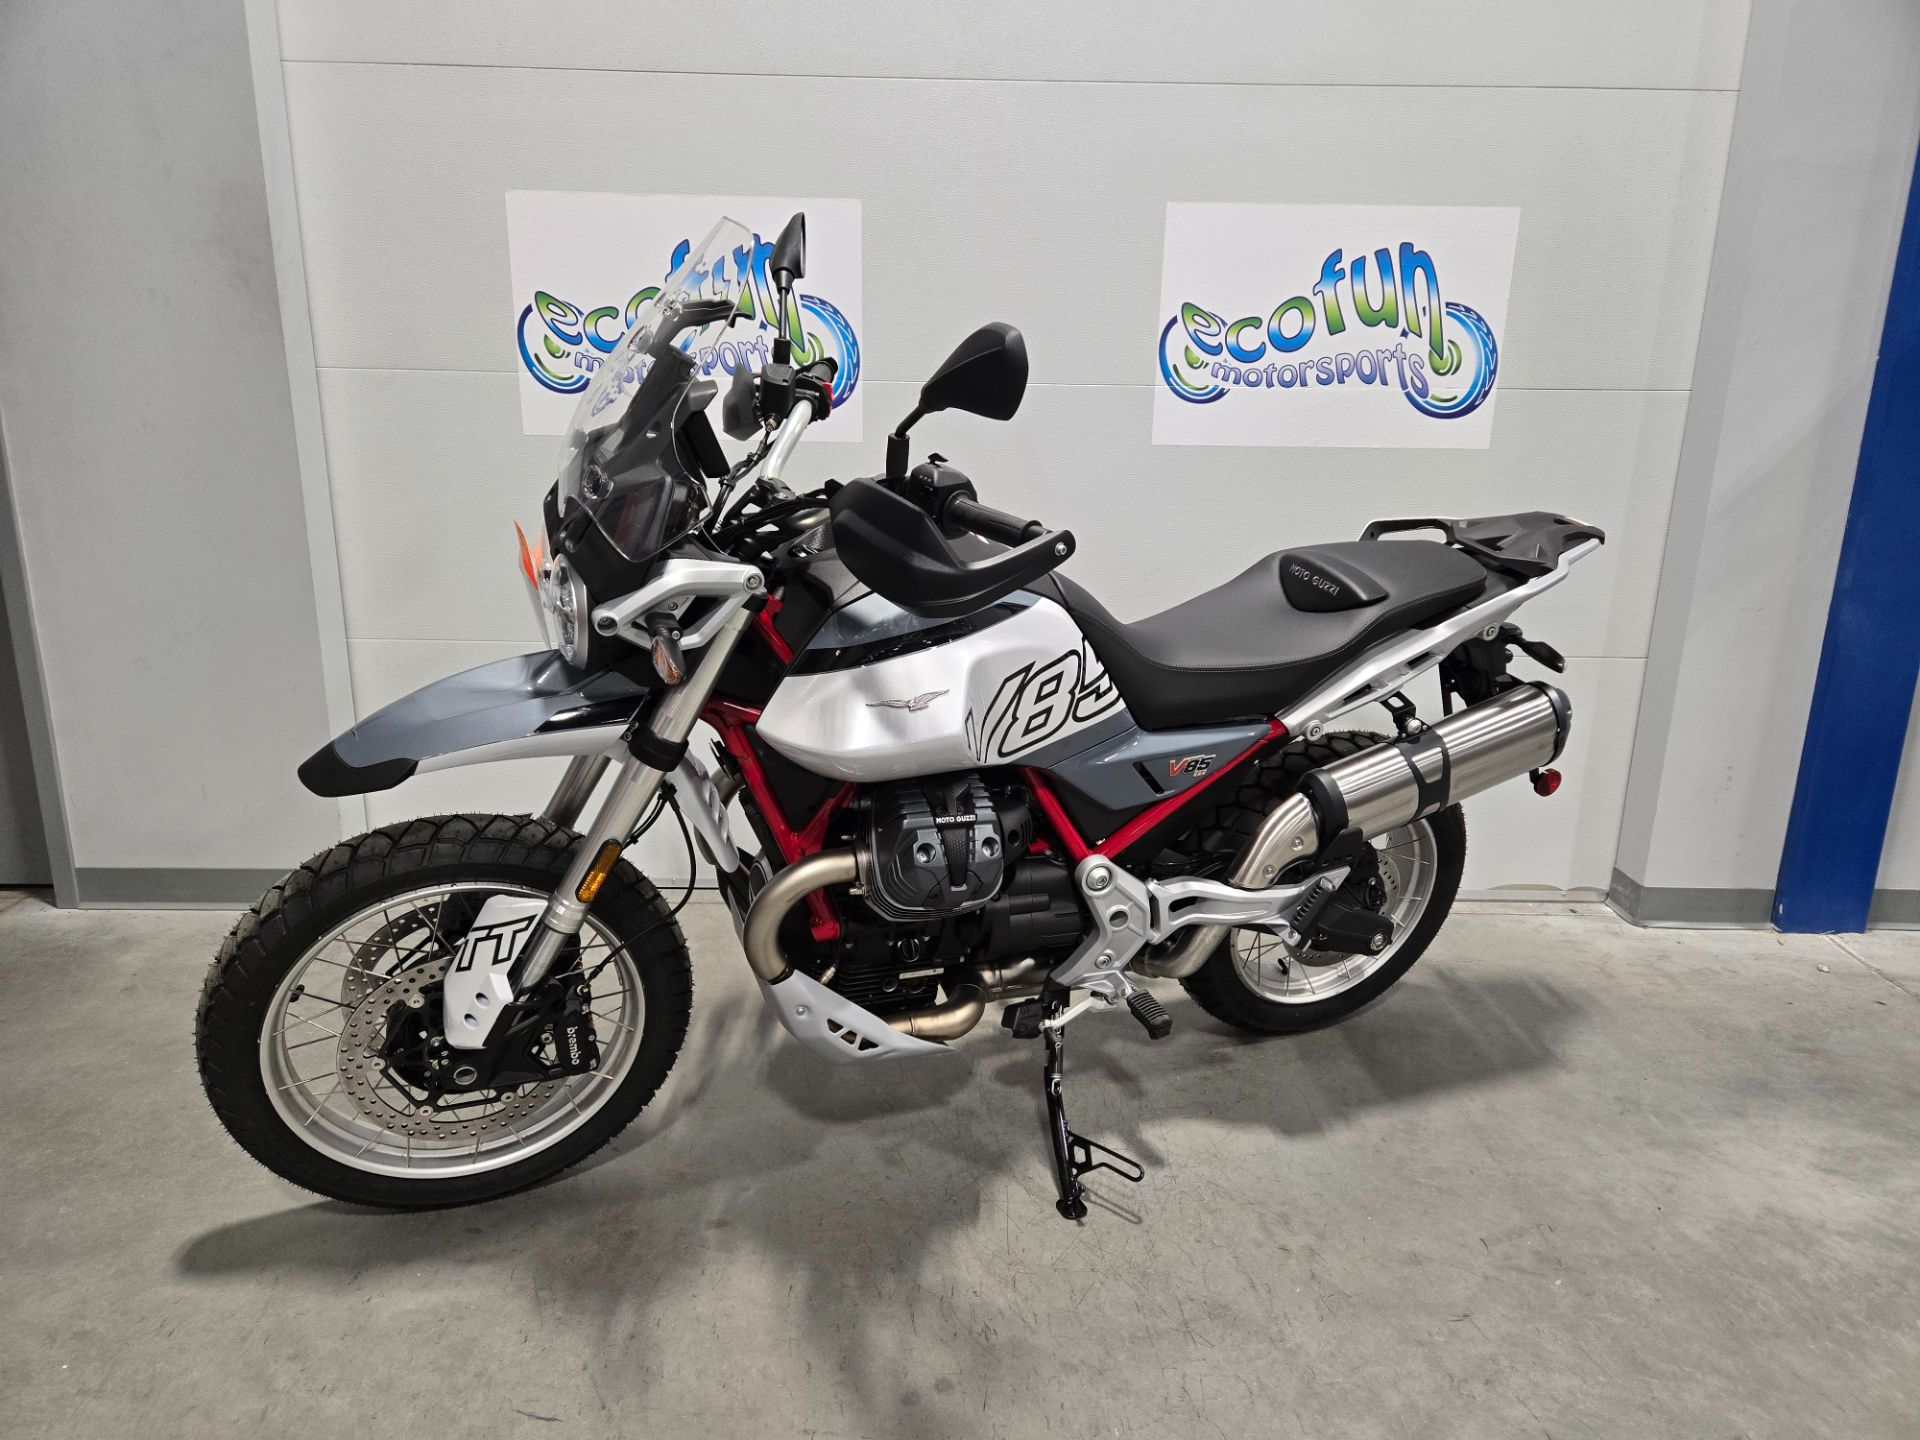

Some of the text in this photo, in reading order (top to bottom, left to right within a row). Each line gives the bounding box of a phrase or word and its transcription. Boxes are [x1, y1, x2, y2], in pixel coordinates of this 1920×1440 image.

[1181, 242, 1444, 361] ecofun
[1210, 343, 1430, 400] motorsports
[1289, 563, 1340, 596] MOTO GUZZI
[1169, 754, 1216, 777] V85
[936, 814, 977, 824] MOTO GUZZI
[455, 913, 539, 973] TT
[566, 1025, 582, 1066] brembo
